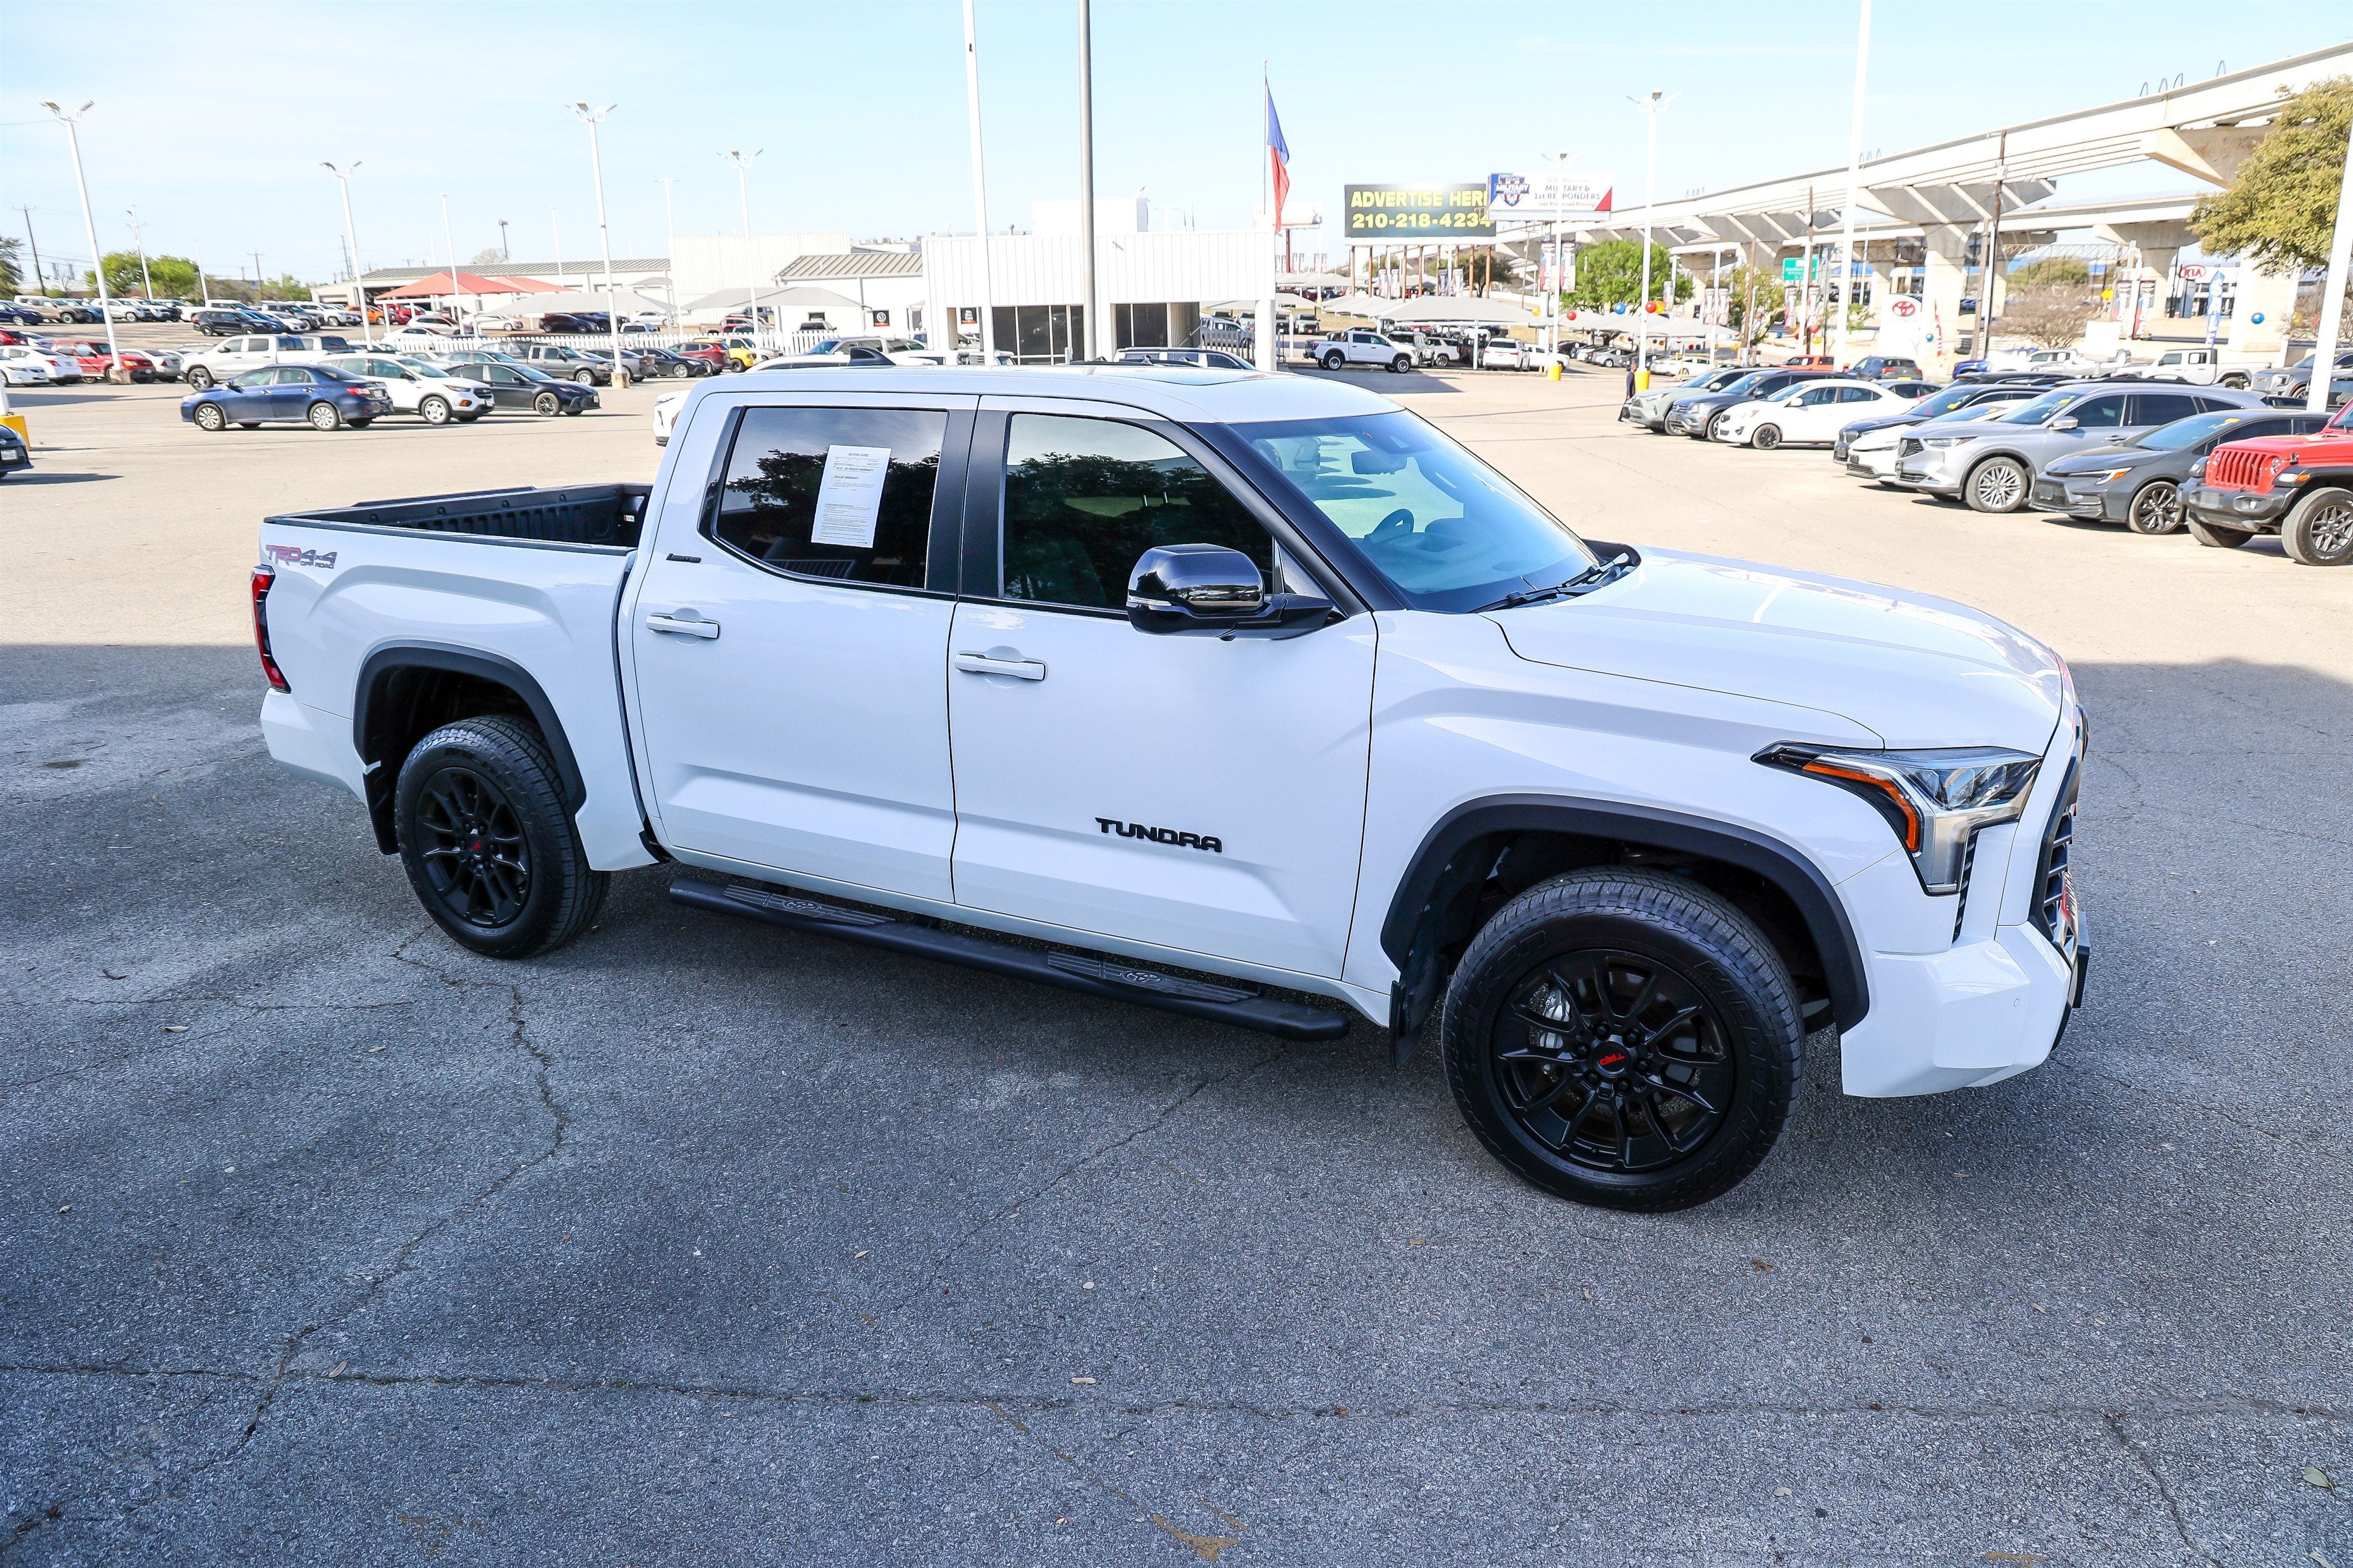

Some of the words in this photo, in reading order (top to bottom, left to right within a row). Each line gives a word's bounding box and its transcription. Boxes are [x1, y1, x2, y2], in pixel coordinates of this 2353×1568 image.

[1350, 190, 1444, 208] ADVERTISE
[1352, 212, 1492, 229] 210-218-4234
[2184, 268, 2202, 277] KIA
[265, 544, 302, 566] TRD
[1094, 816, 1223, 853] TUNDRA
[1599, 1053, 1625, 1066] TRD
